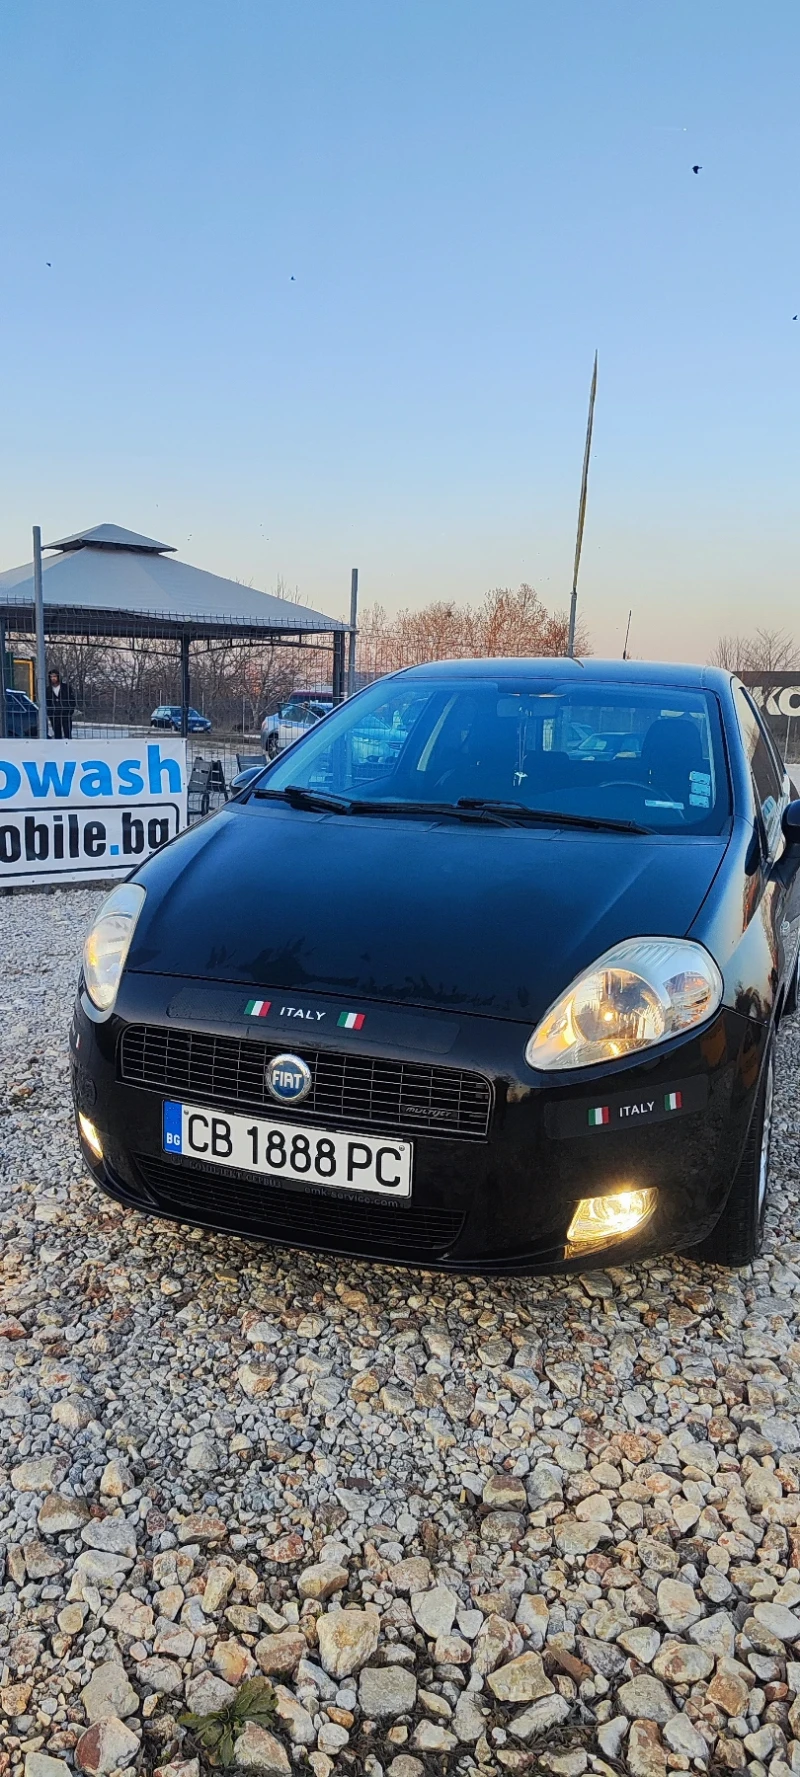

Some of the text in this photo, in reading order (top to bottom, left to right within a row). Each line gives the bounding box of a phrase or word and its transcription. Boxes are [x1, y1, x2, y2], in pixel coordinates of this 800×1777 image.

[279, 1006, 326, 1021] ITALY
[272, 1069, 303, 1090] FIAT
[619, 1101, 655, 1118] ITALY
[166, 1132, 181, 1146] BG
[188, 1113, 401, 1187] CB 1888 PC
